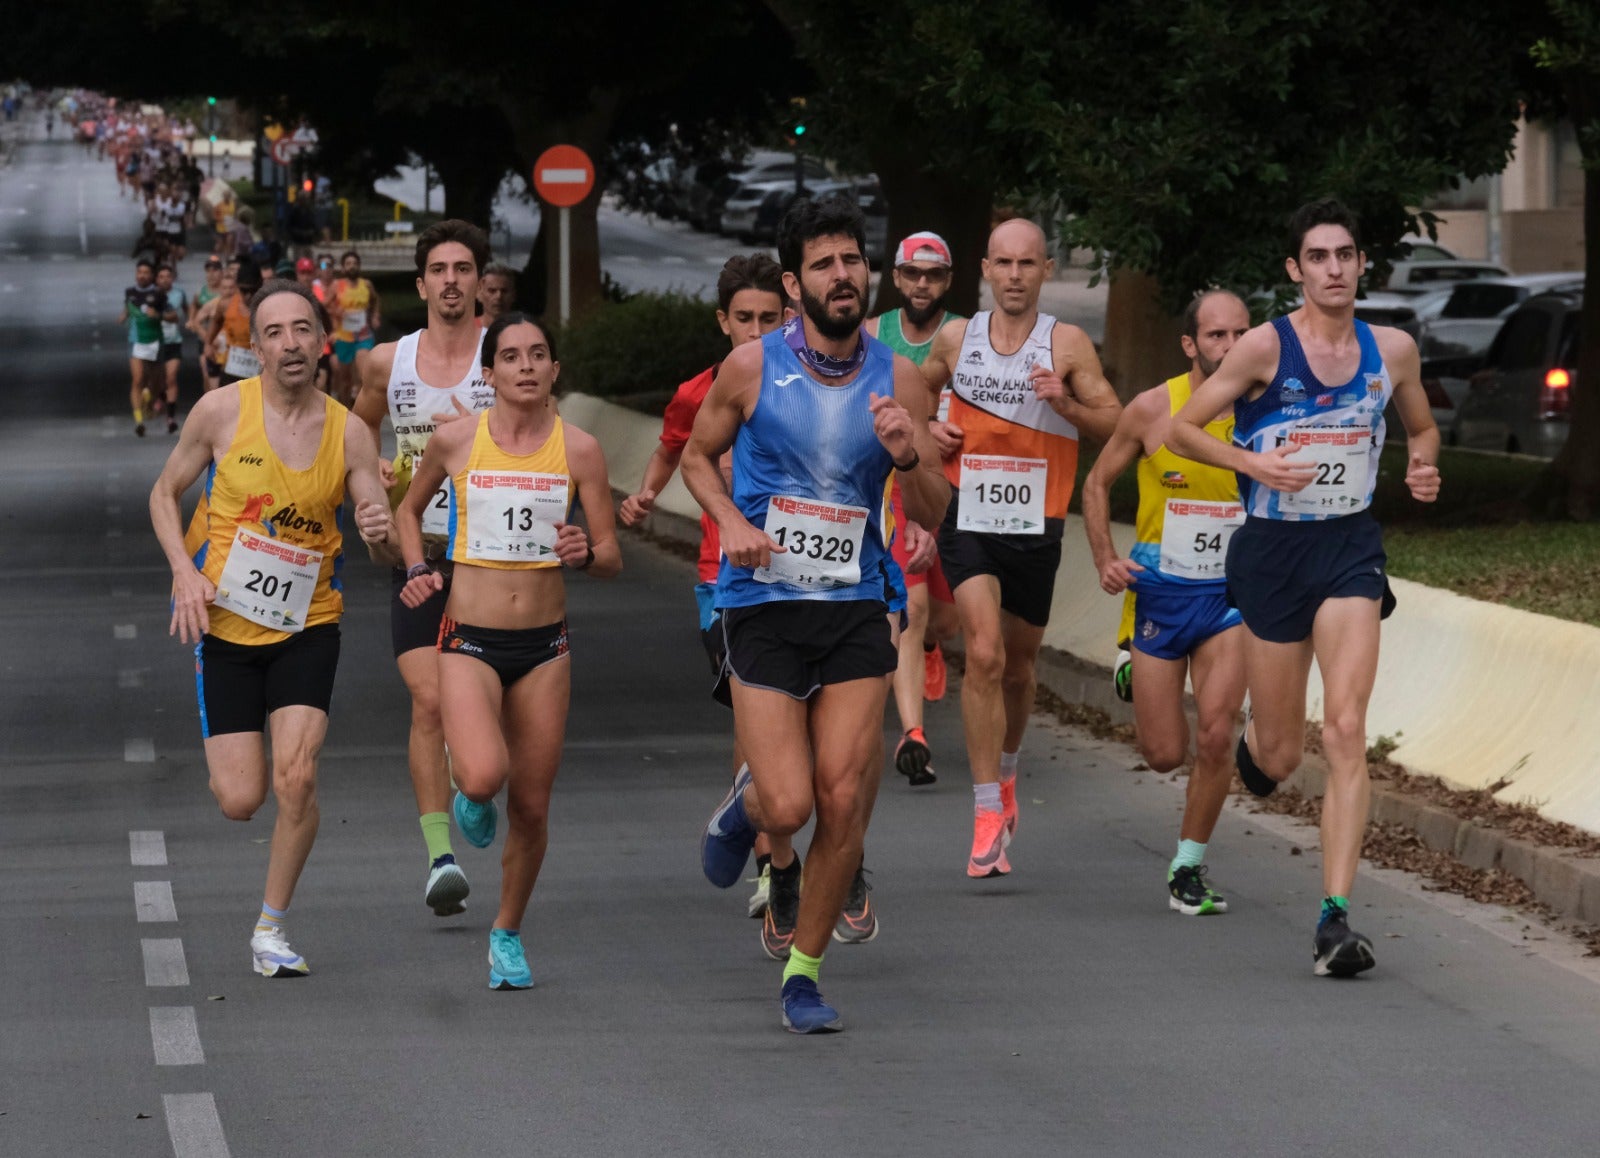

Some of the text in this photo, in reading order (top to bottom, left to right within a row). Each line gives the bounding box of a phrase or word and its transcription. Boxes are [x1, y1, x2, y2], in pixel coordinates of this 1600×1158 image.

[956, 372, 1000, 389] TRIATLÓN
[394, 389, 416, 399] grss
[971, 389, 1024, 404] SENEGAR
[1289, 432, 1311, 445] 42
[963, 458, 982, 471] 42
[1315, 462, 1346, 485] 22
[470, 475, 494, 489] 42
[494, 475, 533, 484] CARRERA
[535, 477, 567, 486] URBANA
[975, 482, 1031, 505] 1500
[772, 497, 797, 515] 42
[796, 502, 837, 514] CARRERA
[1168, 502, 1190, 516] 42
[270, 502, 324, 535] Álora
[503, 507, 533, 531] 13
[774, 526, 854, 563] 13329
[1193, 532, 1222, 553] 54
[244, 569, 293, 603] 201
